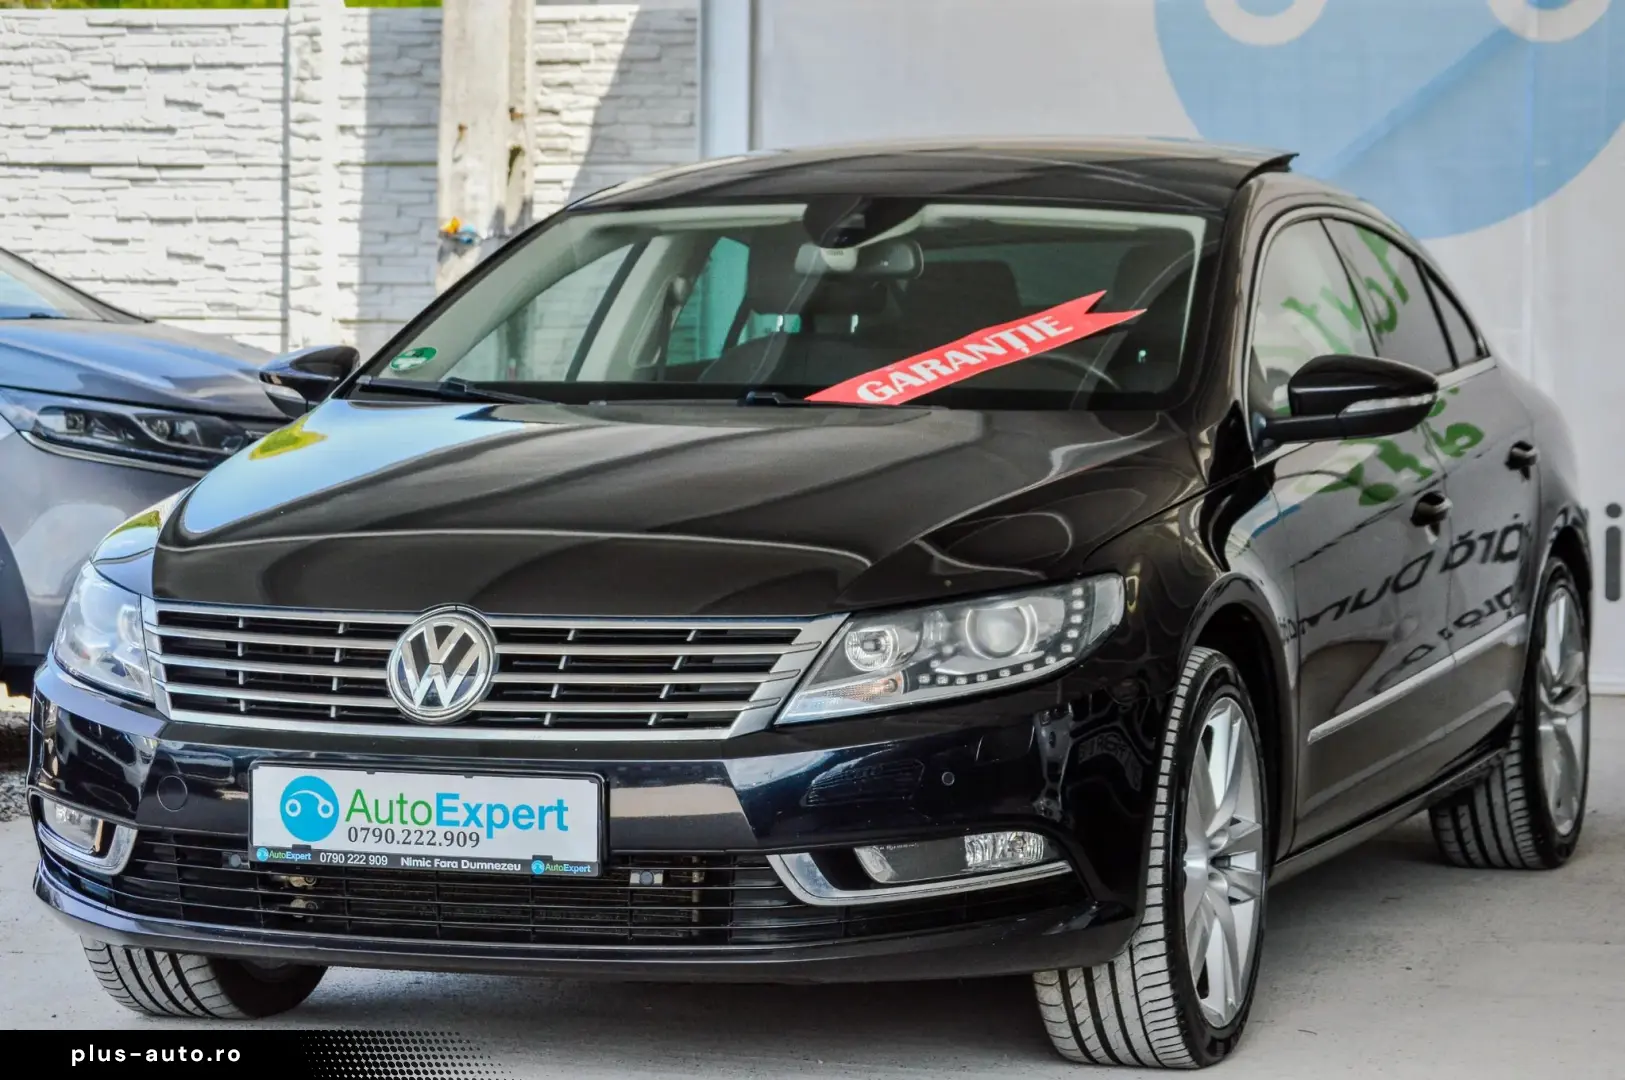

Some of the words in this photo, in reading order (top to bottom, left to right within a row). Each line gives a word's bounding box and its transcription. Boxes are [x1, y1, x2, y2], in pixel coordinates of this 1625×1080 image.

[345, 788, 569, 839] AutoExpert
[347, 826, 481, 848] 0790.222.909
[268, 851, 313, 862] AutoExpert
[319, 852, 345, 864] 0790
[347, 853, 366, 865] 222
[368, 854, 388, 866] 909
[400, 857, 432, 868] Nimic
[434, 858, 459, 869] Fara
[461, 859, 522, 872] Dumnezeu
[544, 863, 592, 875] AutoExpert
